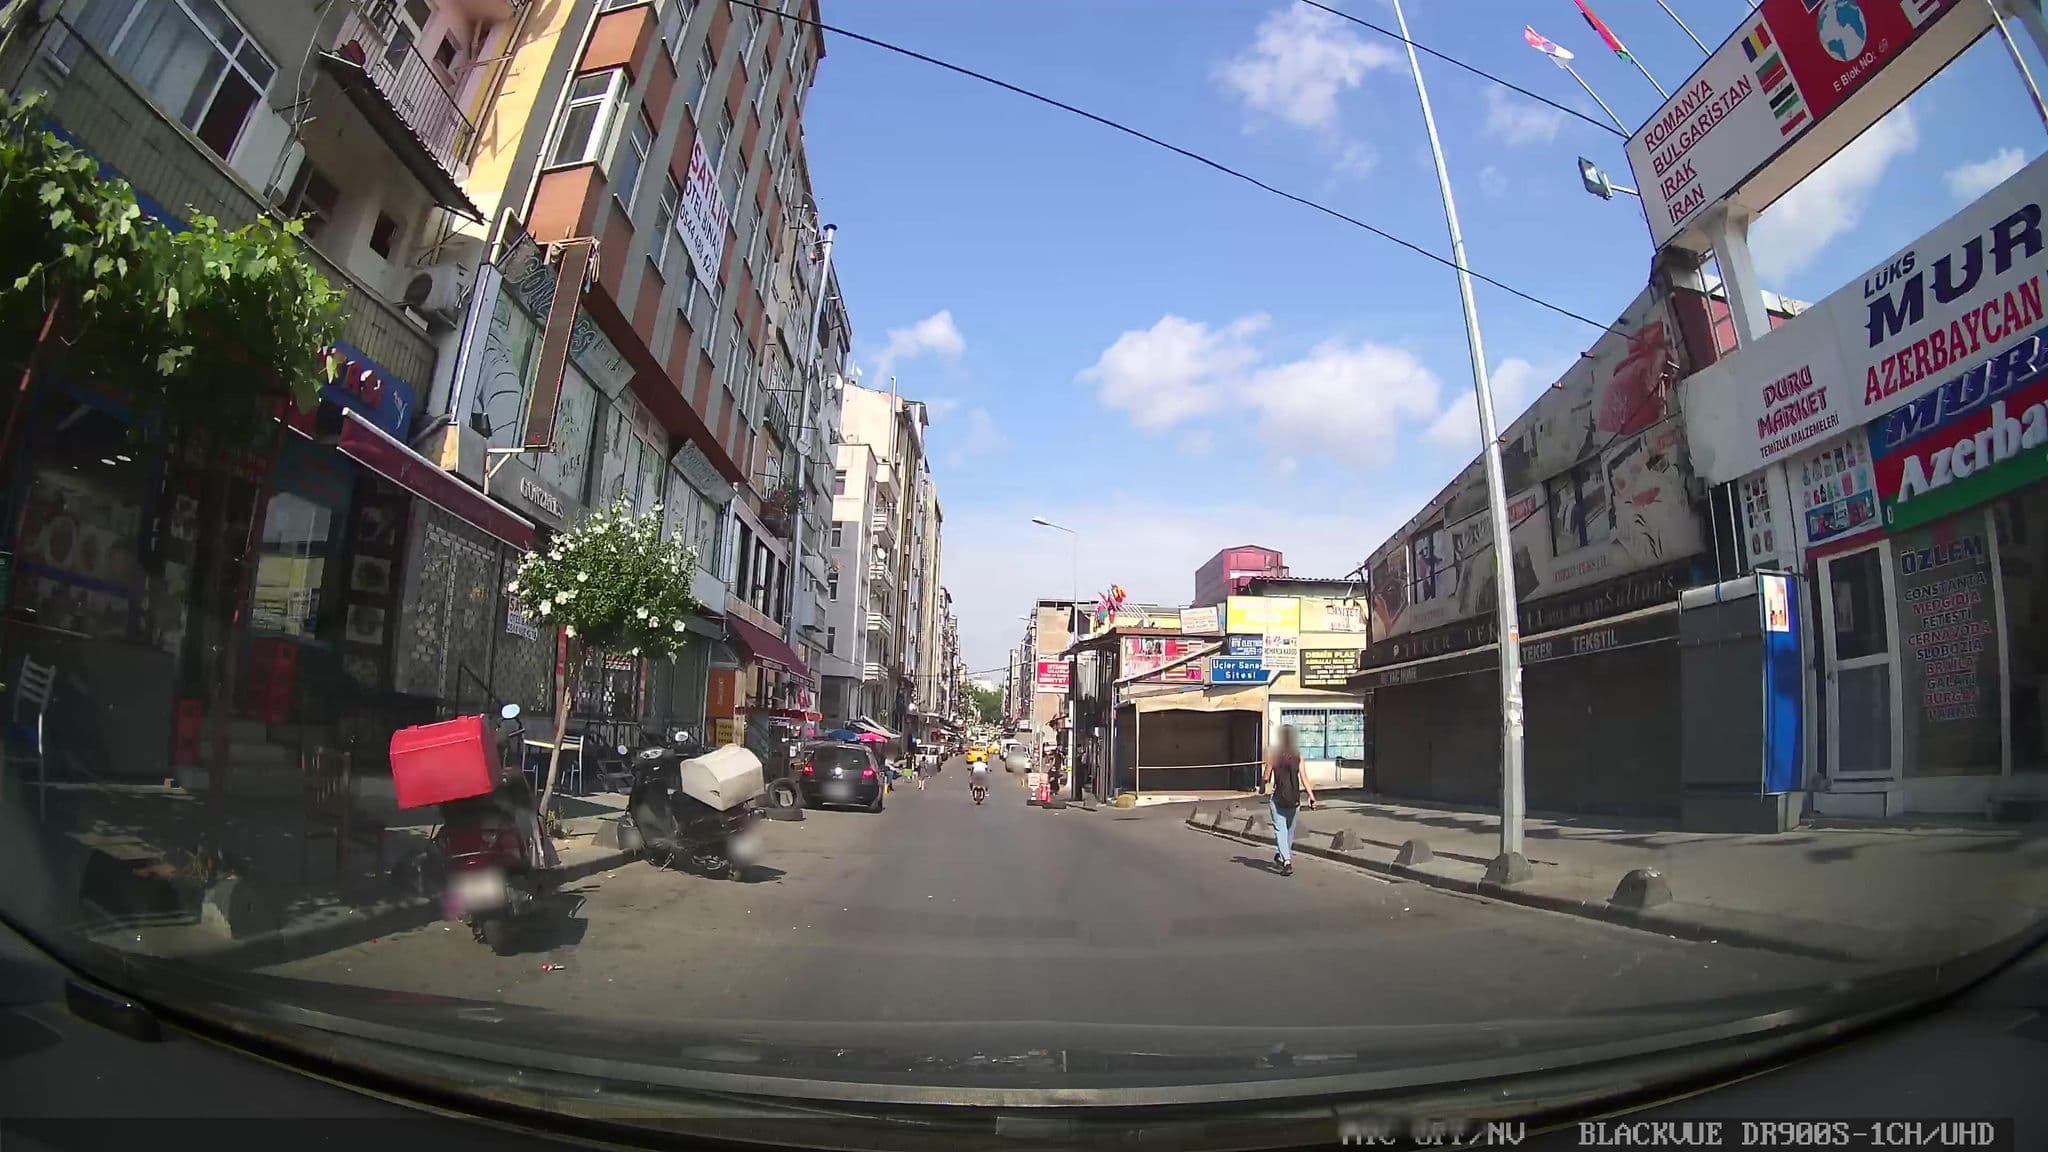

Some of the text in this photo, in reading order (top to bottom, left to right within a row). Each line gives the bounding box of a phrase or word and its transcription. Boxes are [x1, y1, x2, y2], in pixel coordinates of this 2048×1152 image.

[1832, 80, 1841, 92] E
[1841, 64, 1860, 86] Blok
[1644, 79, 1713, 152] ROMANYA
[1652, 74, 1753, 177] BULGARİSTAN
[685, 176, 702, 221] OTEL
[692, 143, 728, 232] SATILIK
[1660, 158, 1697, 200] IRAK
[1667, 184, 1705, 223] İRAN
[1864, 251, 1915, 298] LÜKS
[1864, 203, 2045, 348] MUR
[1864, 275, 2044, 407] AZERBAYCAN
[1763, 364, 1813, 408] DURU
[1885, 334, 2048, 448] MUR
[1757, 386, 1827, 440] MARKET
[1760, 410, 1840, 459] TEMİZLİK MALZEMELERİ
[1896, 401, 2048, 503] Azerba
[1901, 535, 1984, 576] ÖZLEM
[1239, 661, 1263, 670] Sana
[1521, 627, 1618, 662] TEKER TEKSTİL
[1916, 639, 1984, 661] SLOBOZIA
[1225, 671, 1256, 680] Sitesi
